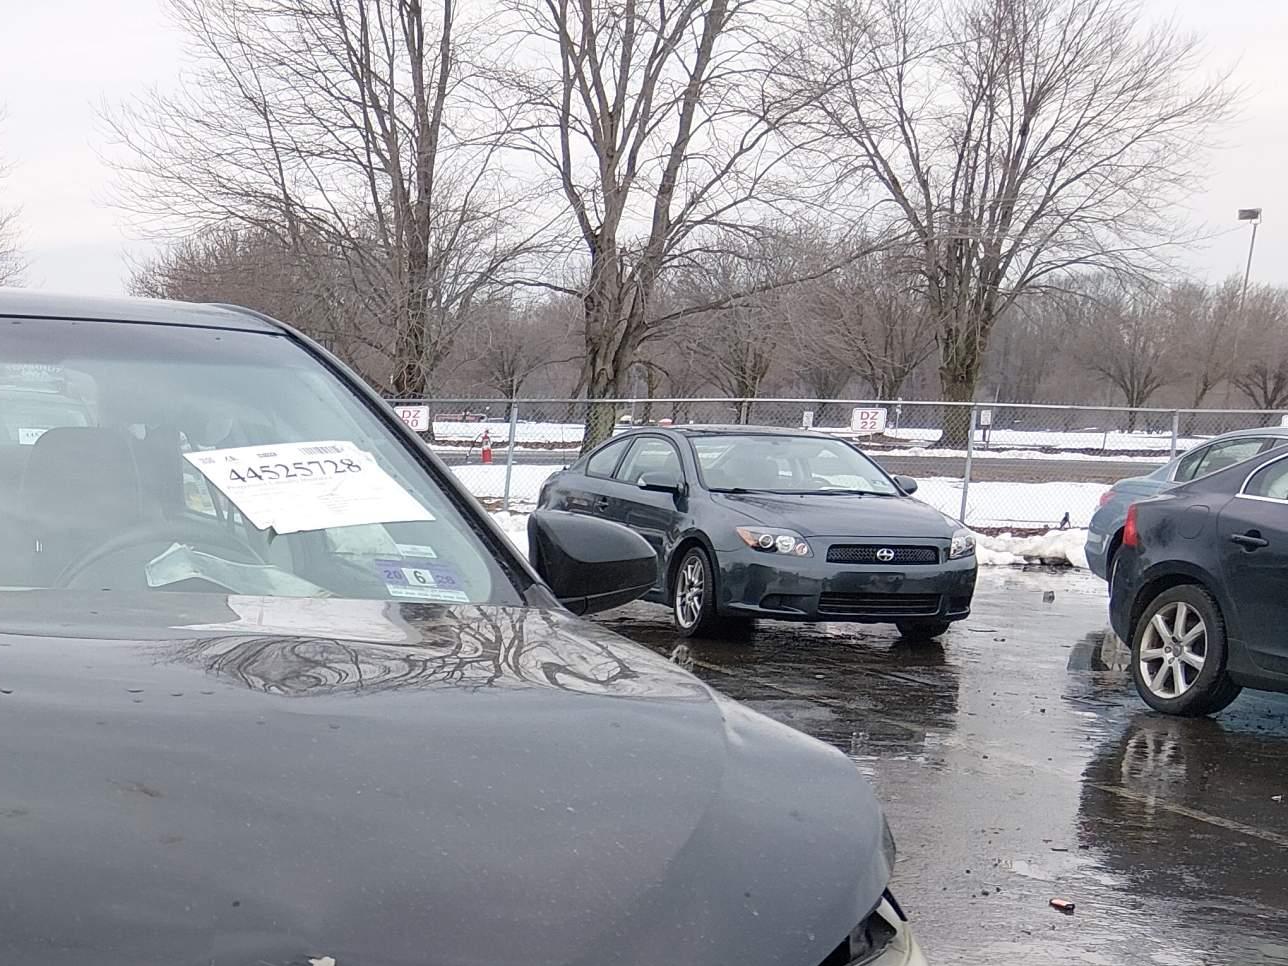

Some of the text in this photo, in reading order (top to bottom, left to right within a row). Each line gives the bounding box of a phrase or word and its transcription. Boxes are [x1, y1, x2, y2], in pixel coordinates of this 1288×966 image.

[402, 409, 421, 419] DZ
[860, 411, 879, 421] DZ
[860, 421, 877, 430] 22
[228, 458, 362, 483] 44525728
[383, 569, 402, 580] 20
[413, 570, 426, 584] 6
